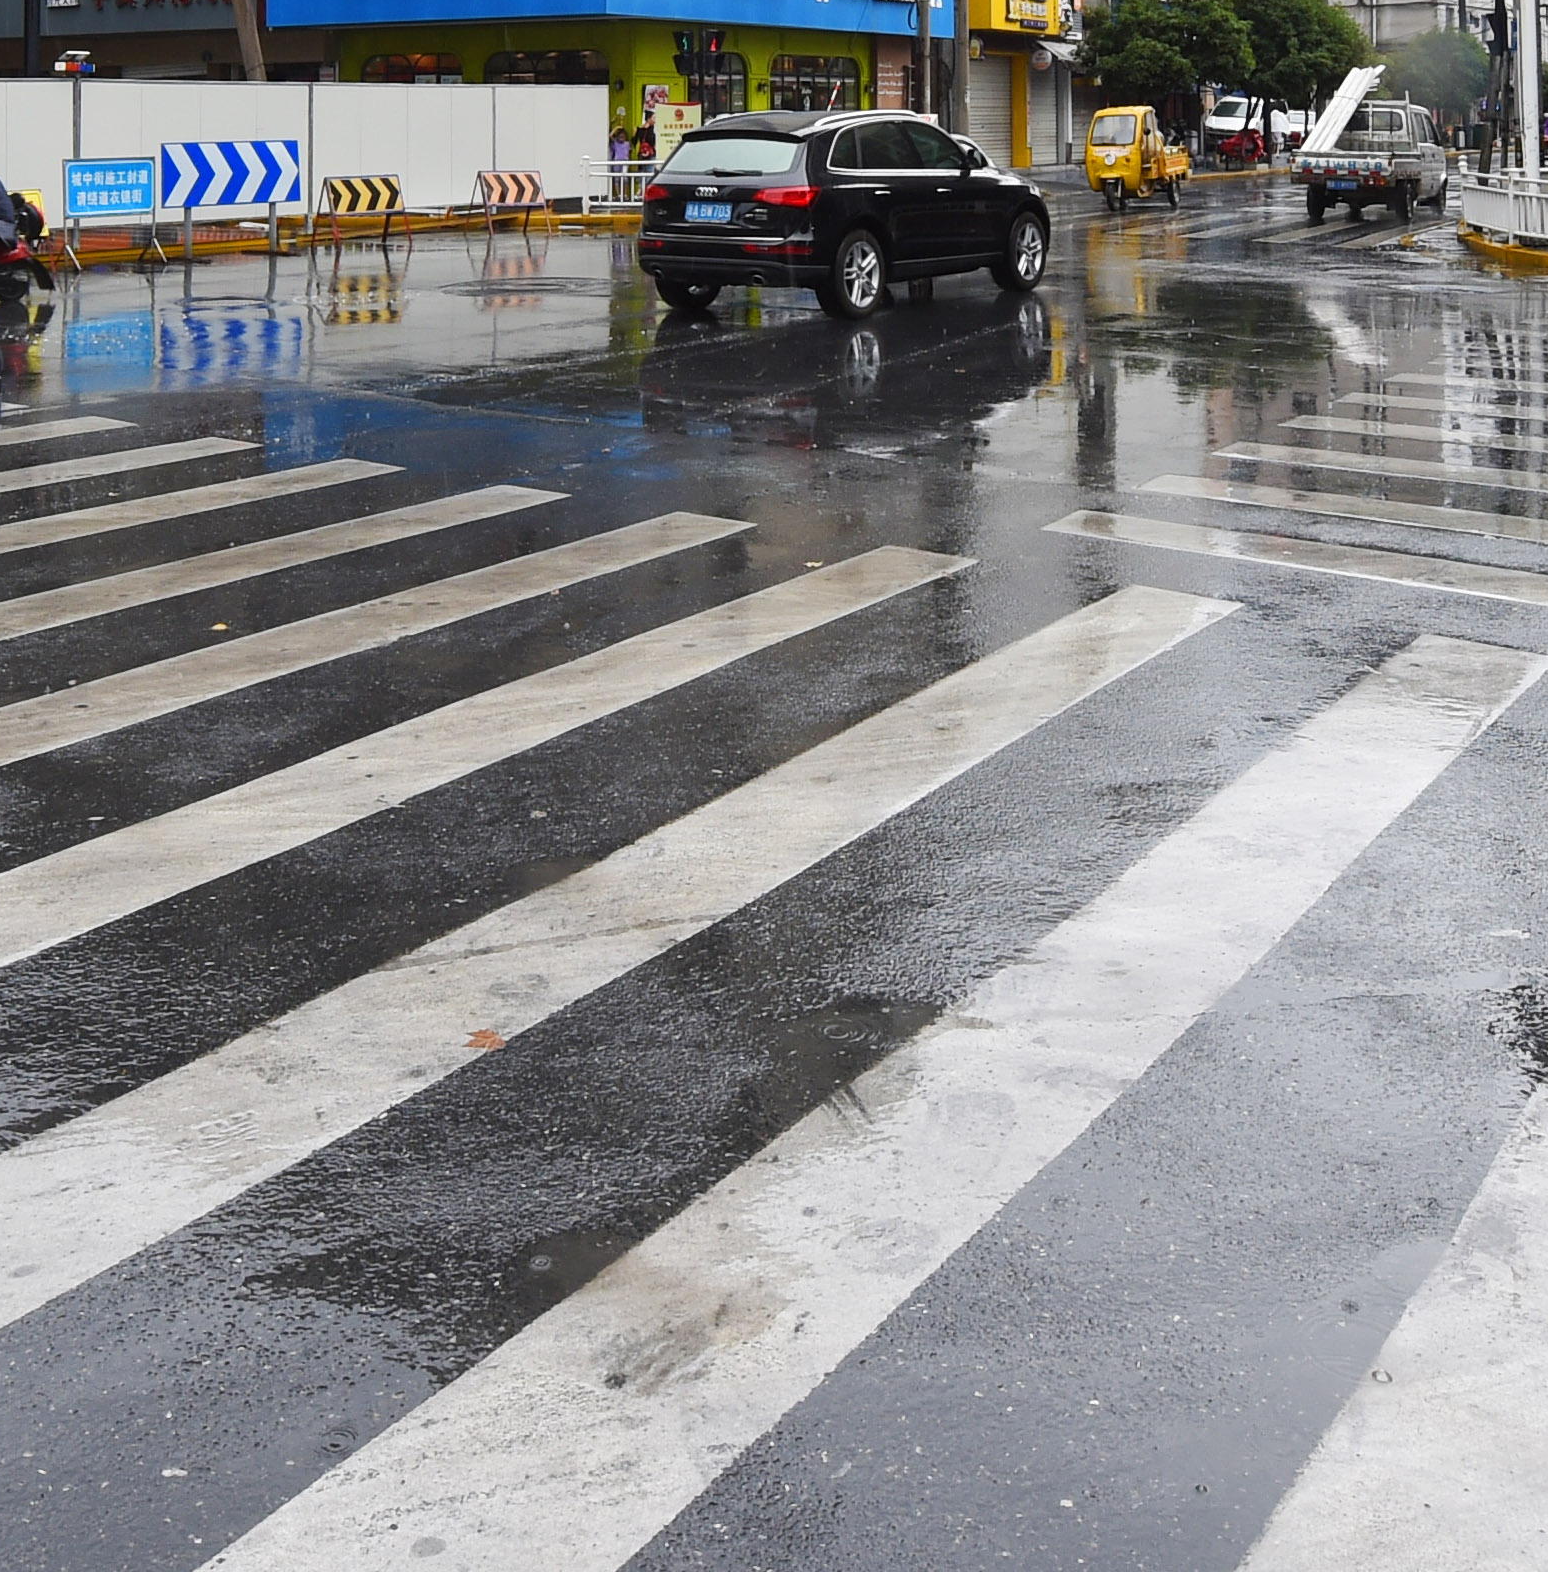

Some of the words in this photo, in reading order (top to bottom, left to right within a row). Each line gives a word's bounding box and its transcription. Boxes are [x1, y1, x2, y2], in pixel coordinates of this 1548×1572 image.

[71, 169, 149, 187] 城中街施工封道
